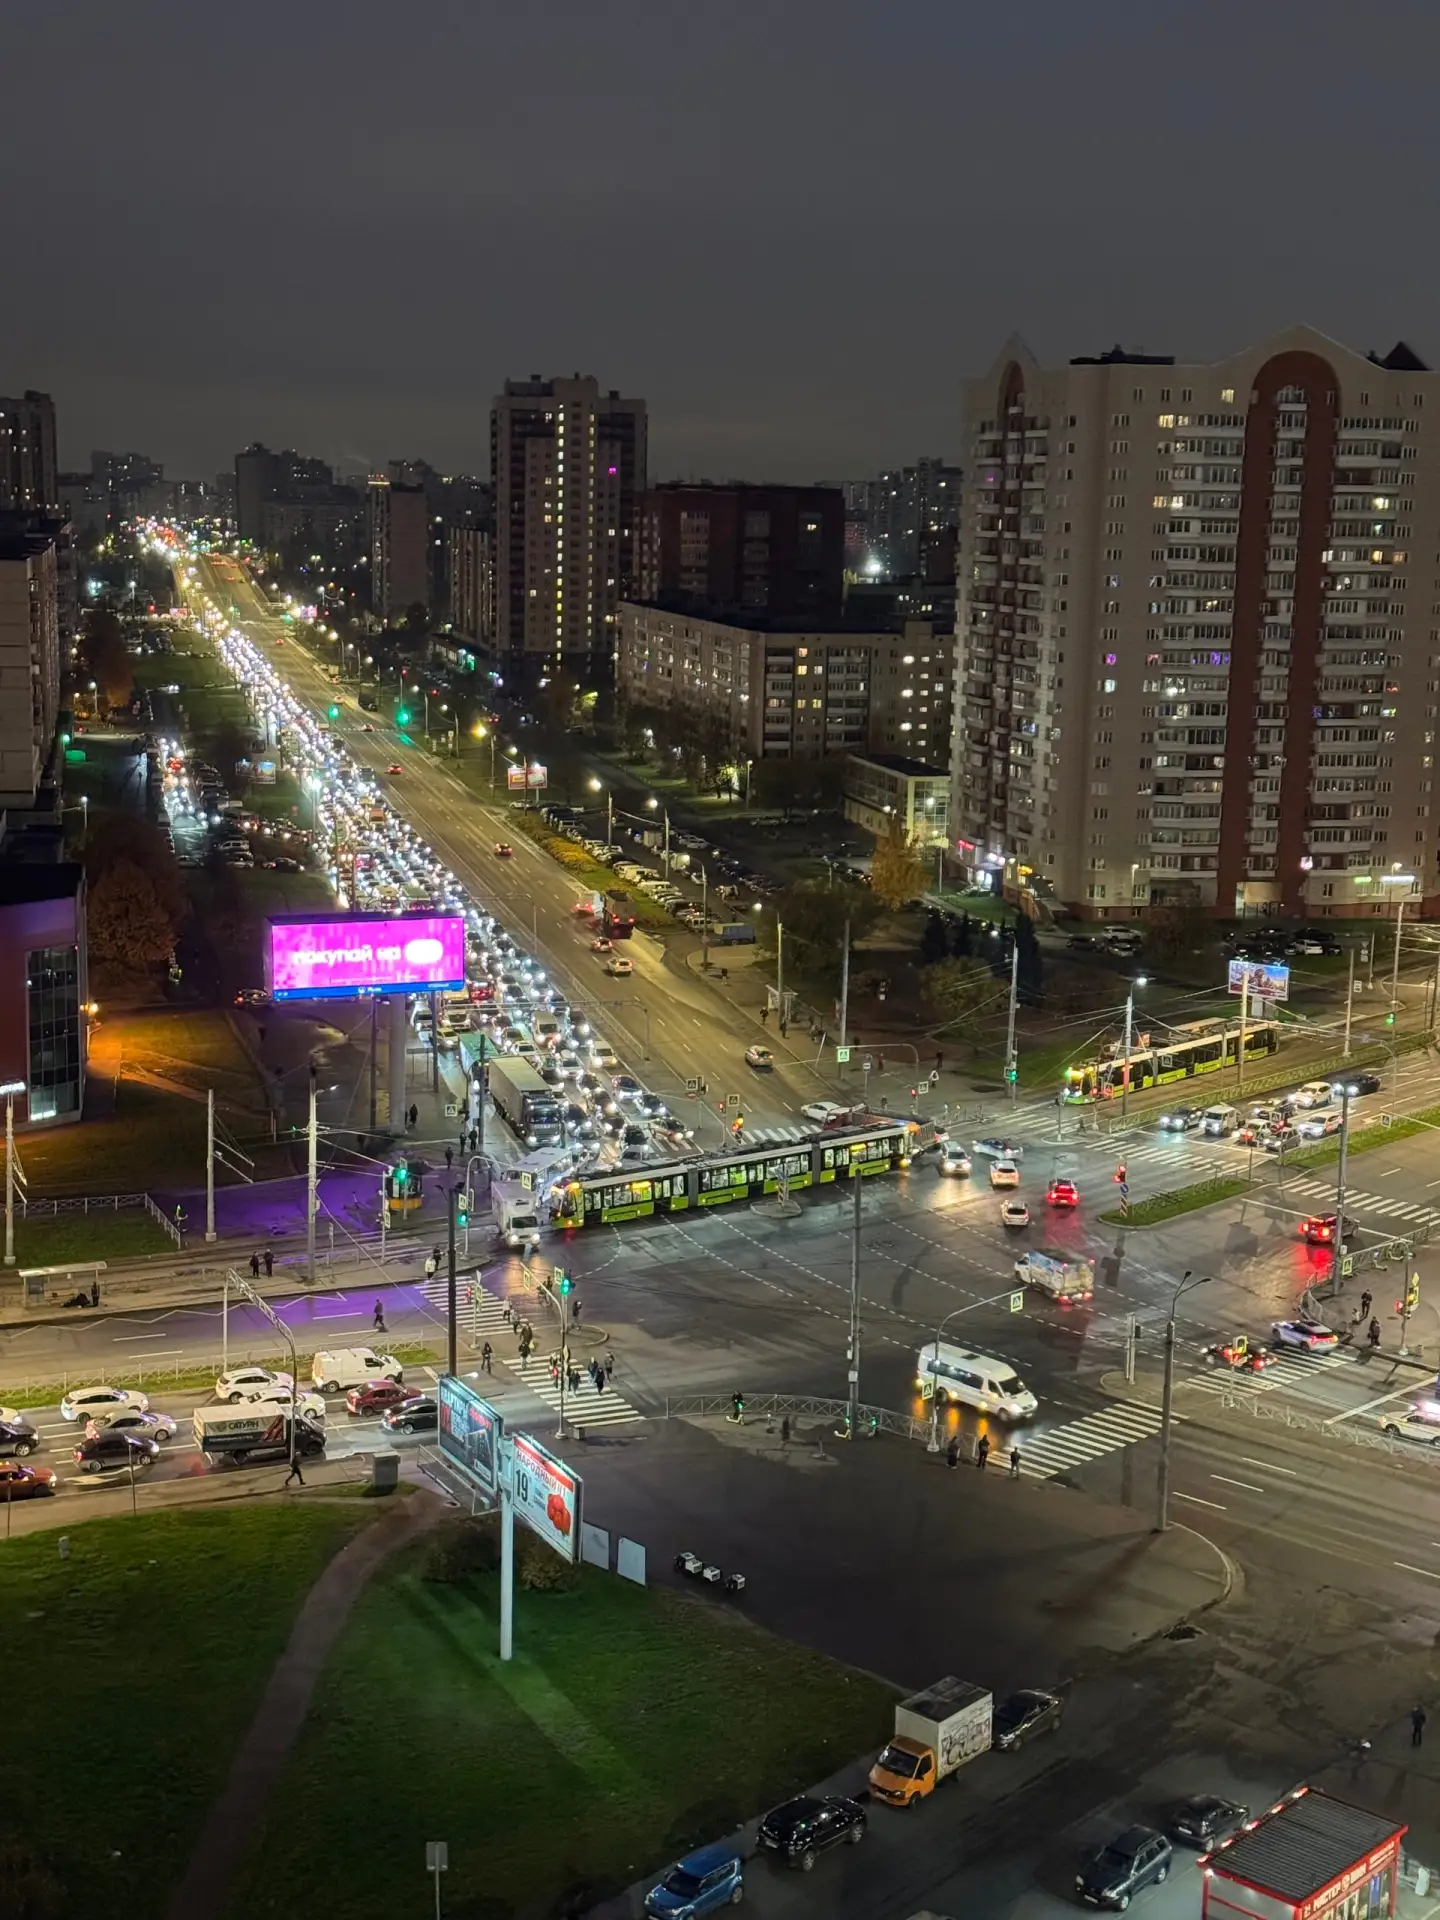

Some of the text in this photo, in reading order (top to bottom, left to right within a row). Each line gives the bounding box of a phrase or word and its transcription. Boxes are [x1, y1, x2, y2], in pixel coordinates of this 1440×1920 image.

[292, 945, 402, 967] покупай на
[228, 1420, 259, 1431] САТУРН
[516, 1449, 557, 1490] НАРОДНЫЙ
[515, 1468, 529, 1503] 19
